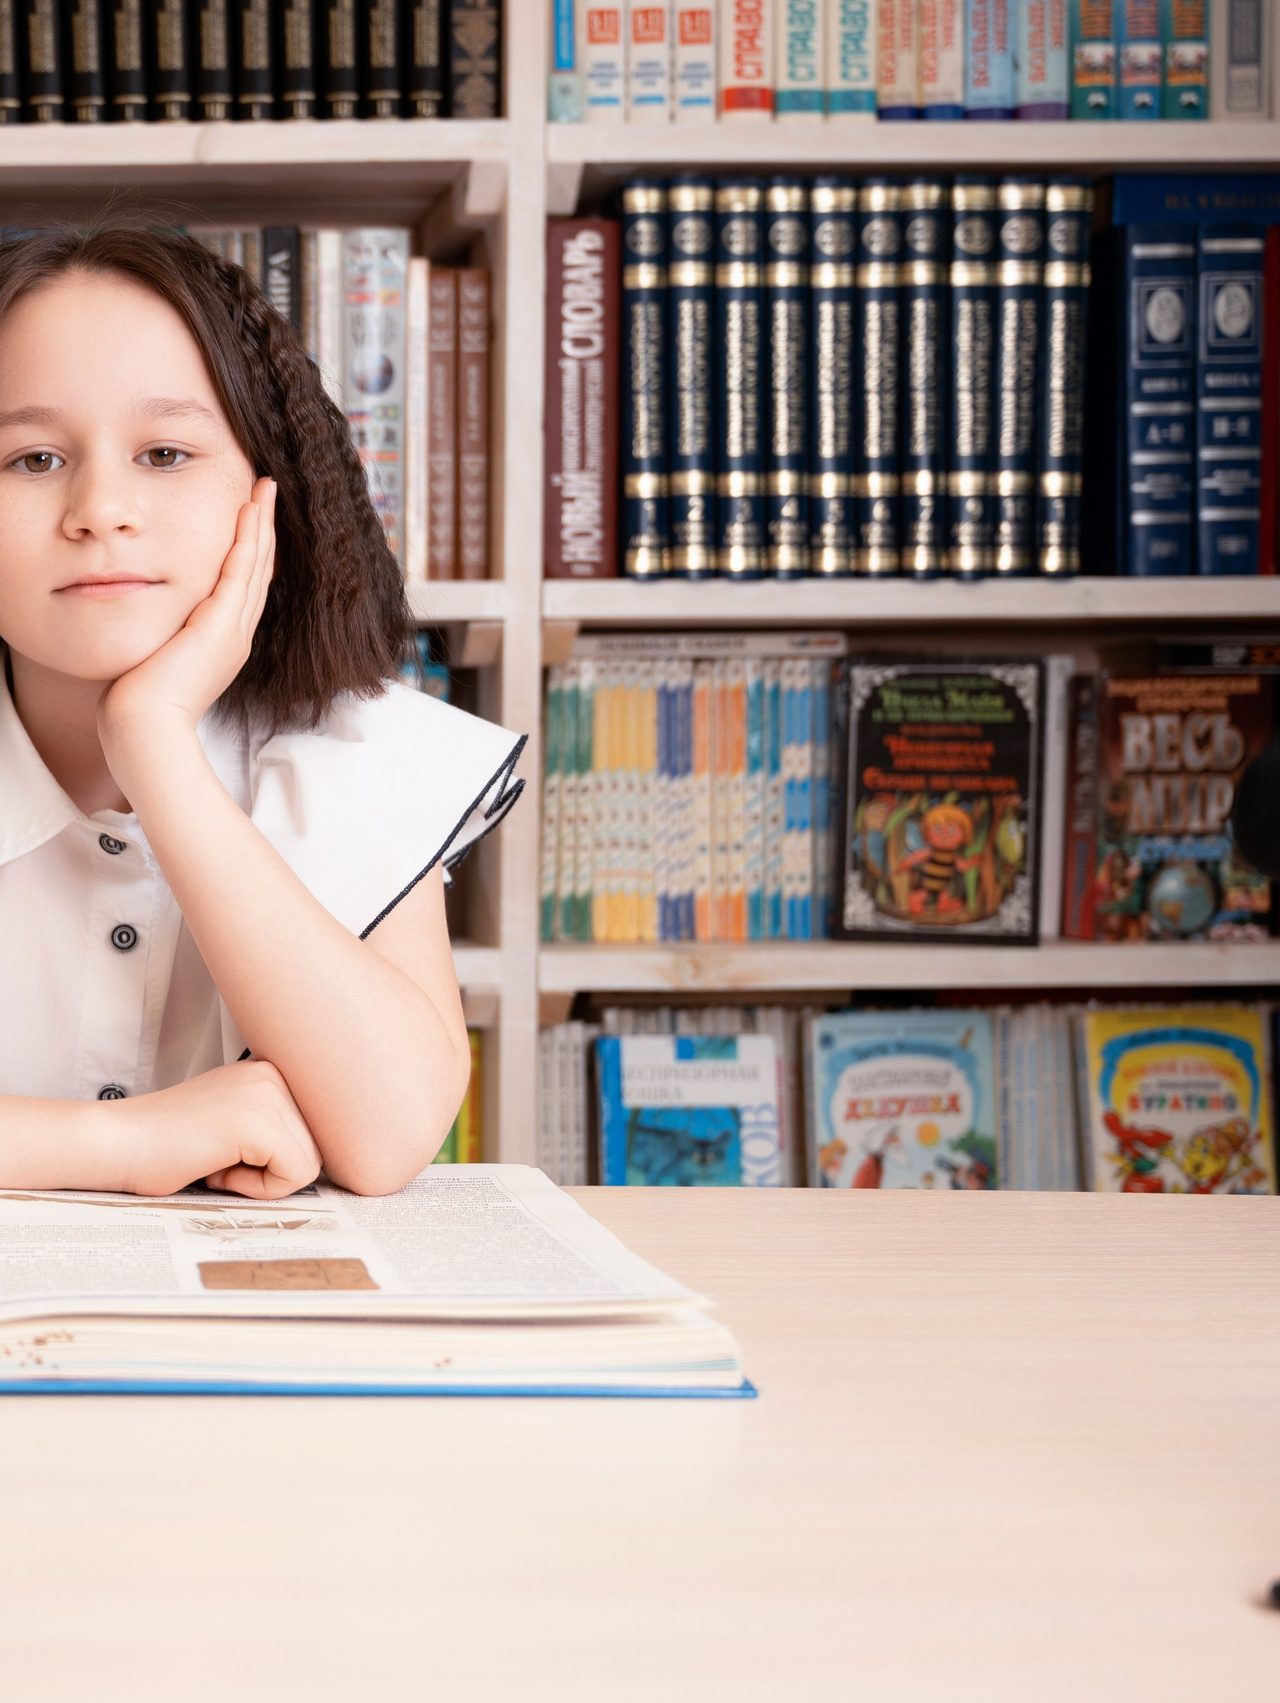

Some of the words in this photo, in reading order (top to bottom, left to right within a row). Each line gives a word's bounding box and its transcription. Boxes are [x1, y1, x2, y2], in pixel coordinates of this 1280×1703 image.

[562, 230, 604, 358] СЛОВАРЬ
[551, 471, 603, 563] НОВЫЙ
[688, 496, 705, 521] 2
[781, 496, 799, 519] 4
[827, 499, 844, 523] 5
[873, 499, 891, 523] 6
[918, 496, 934, 523] 7
[964, 497, 983, 522] 9
[1120, 711, 1245, 772] ВЕСЬ
[1126, 775, 1235, 834] МИР
[843, 1092, 962, 1122] ДЕДУШКА
[1126, 1092, 1238, 1112] БУРАТИНО
